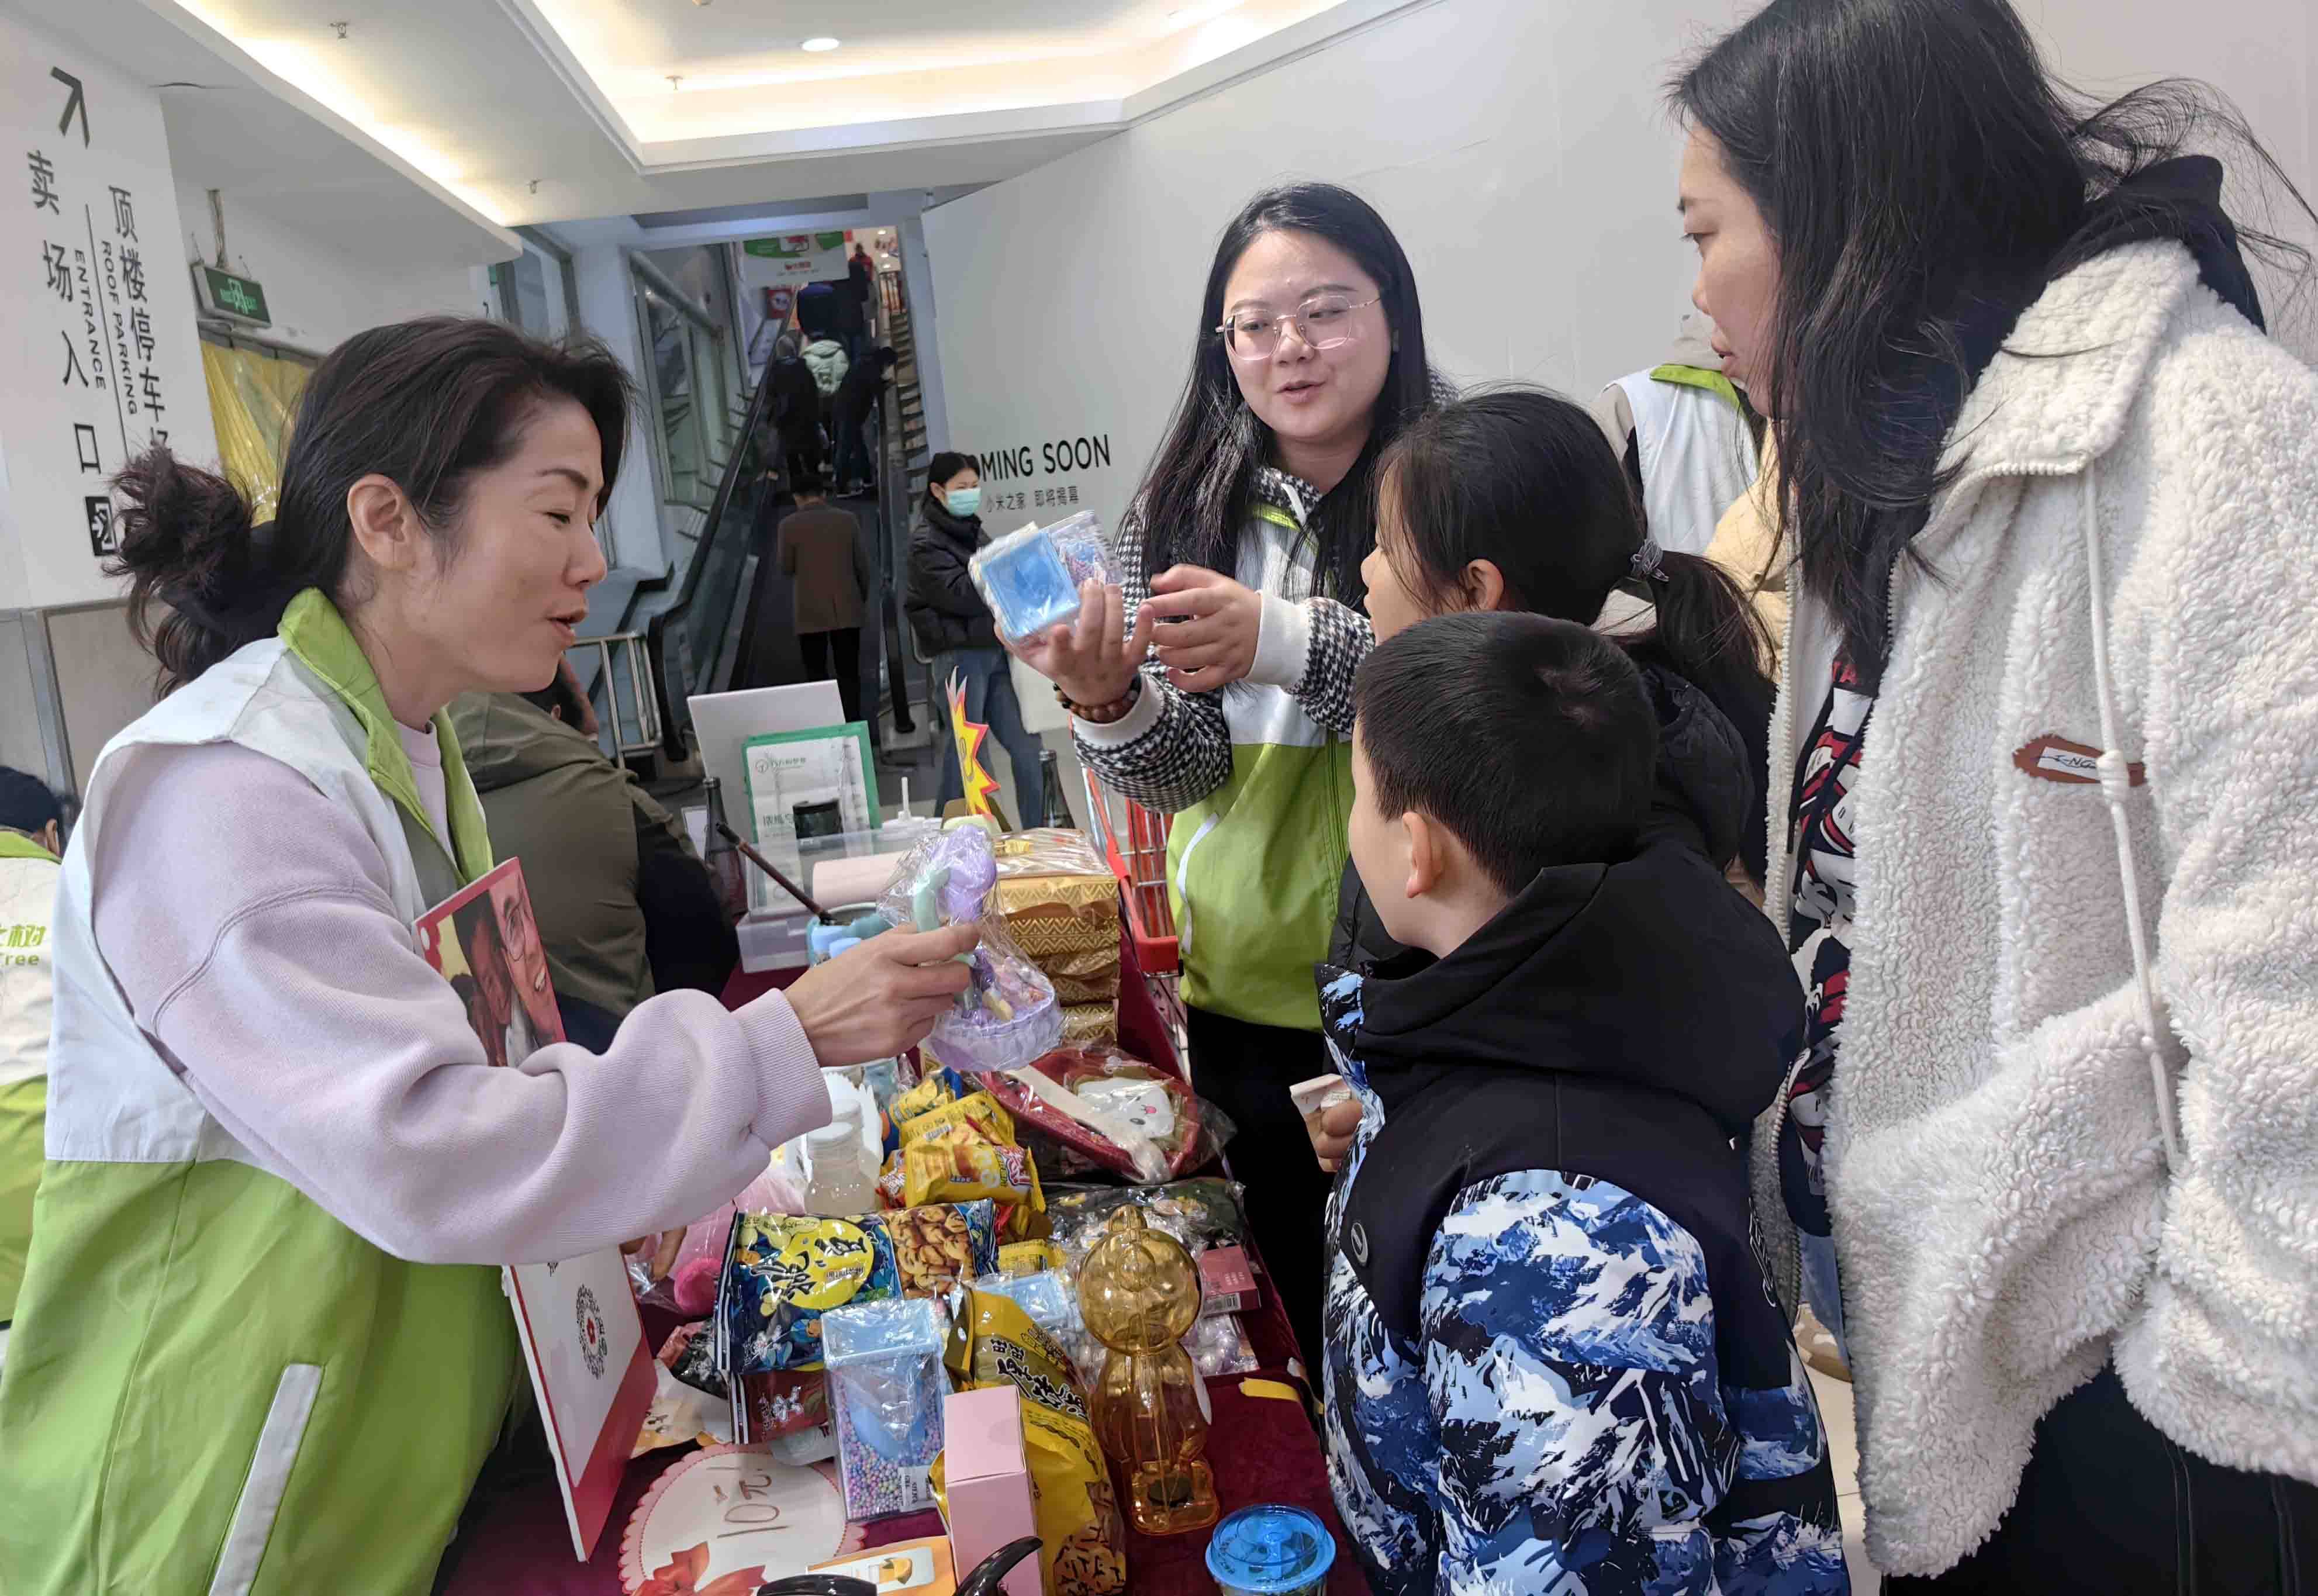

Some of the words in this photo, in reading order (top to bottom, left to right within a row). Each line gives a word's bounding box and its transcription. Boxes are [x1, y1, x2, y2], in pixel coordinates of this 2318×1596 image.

[27, 149, 102, 475] 卖场入口
[75, 249, 106, 390] ENTRANCE
[102, 240, 119, 304] ROOF
[113, 312, 138, 414] PARKING
[980, 446, 1034, 482] MING
[1043, 434, 1110, 474] SOON
[0, 925, 47, 947] 树
[990, 1338, 1025, 1361] 旺旺
